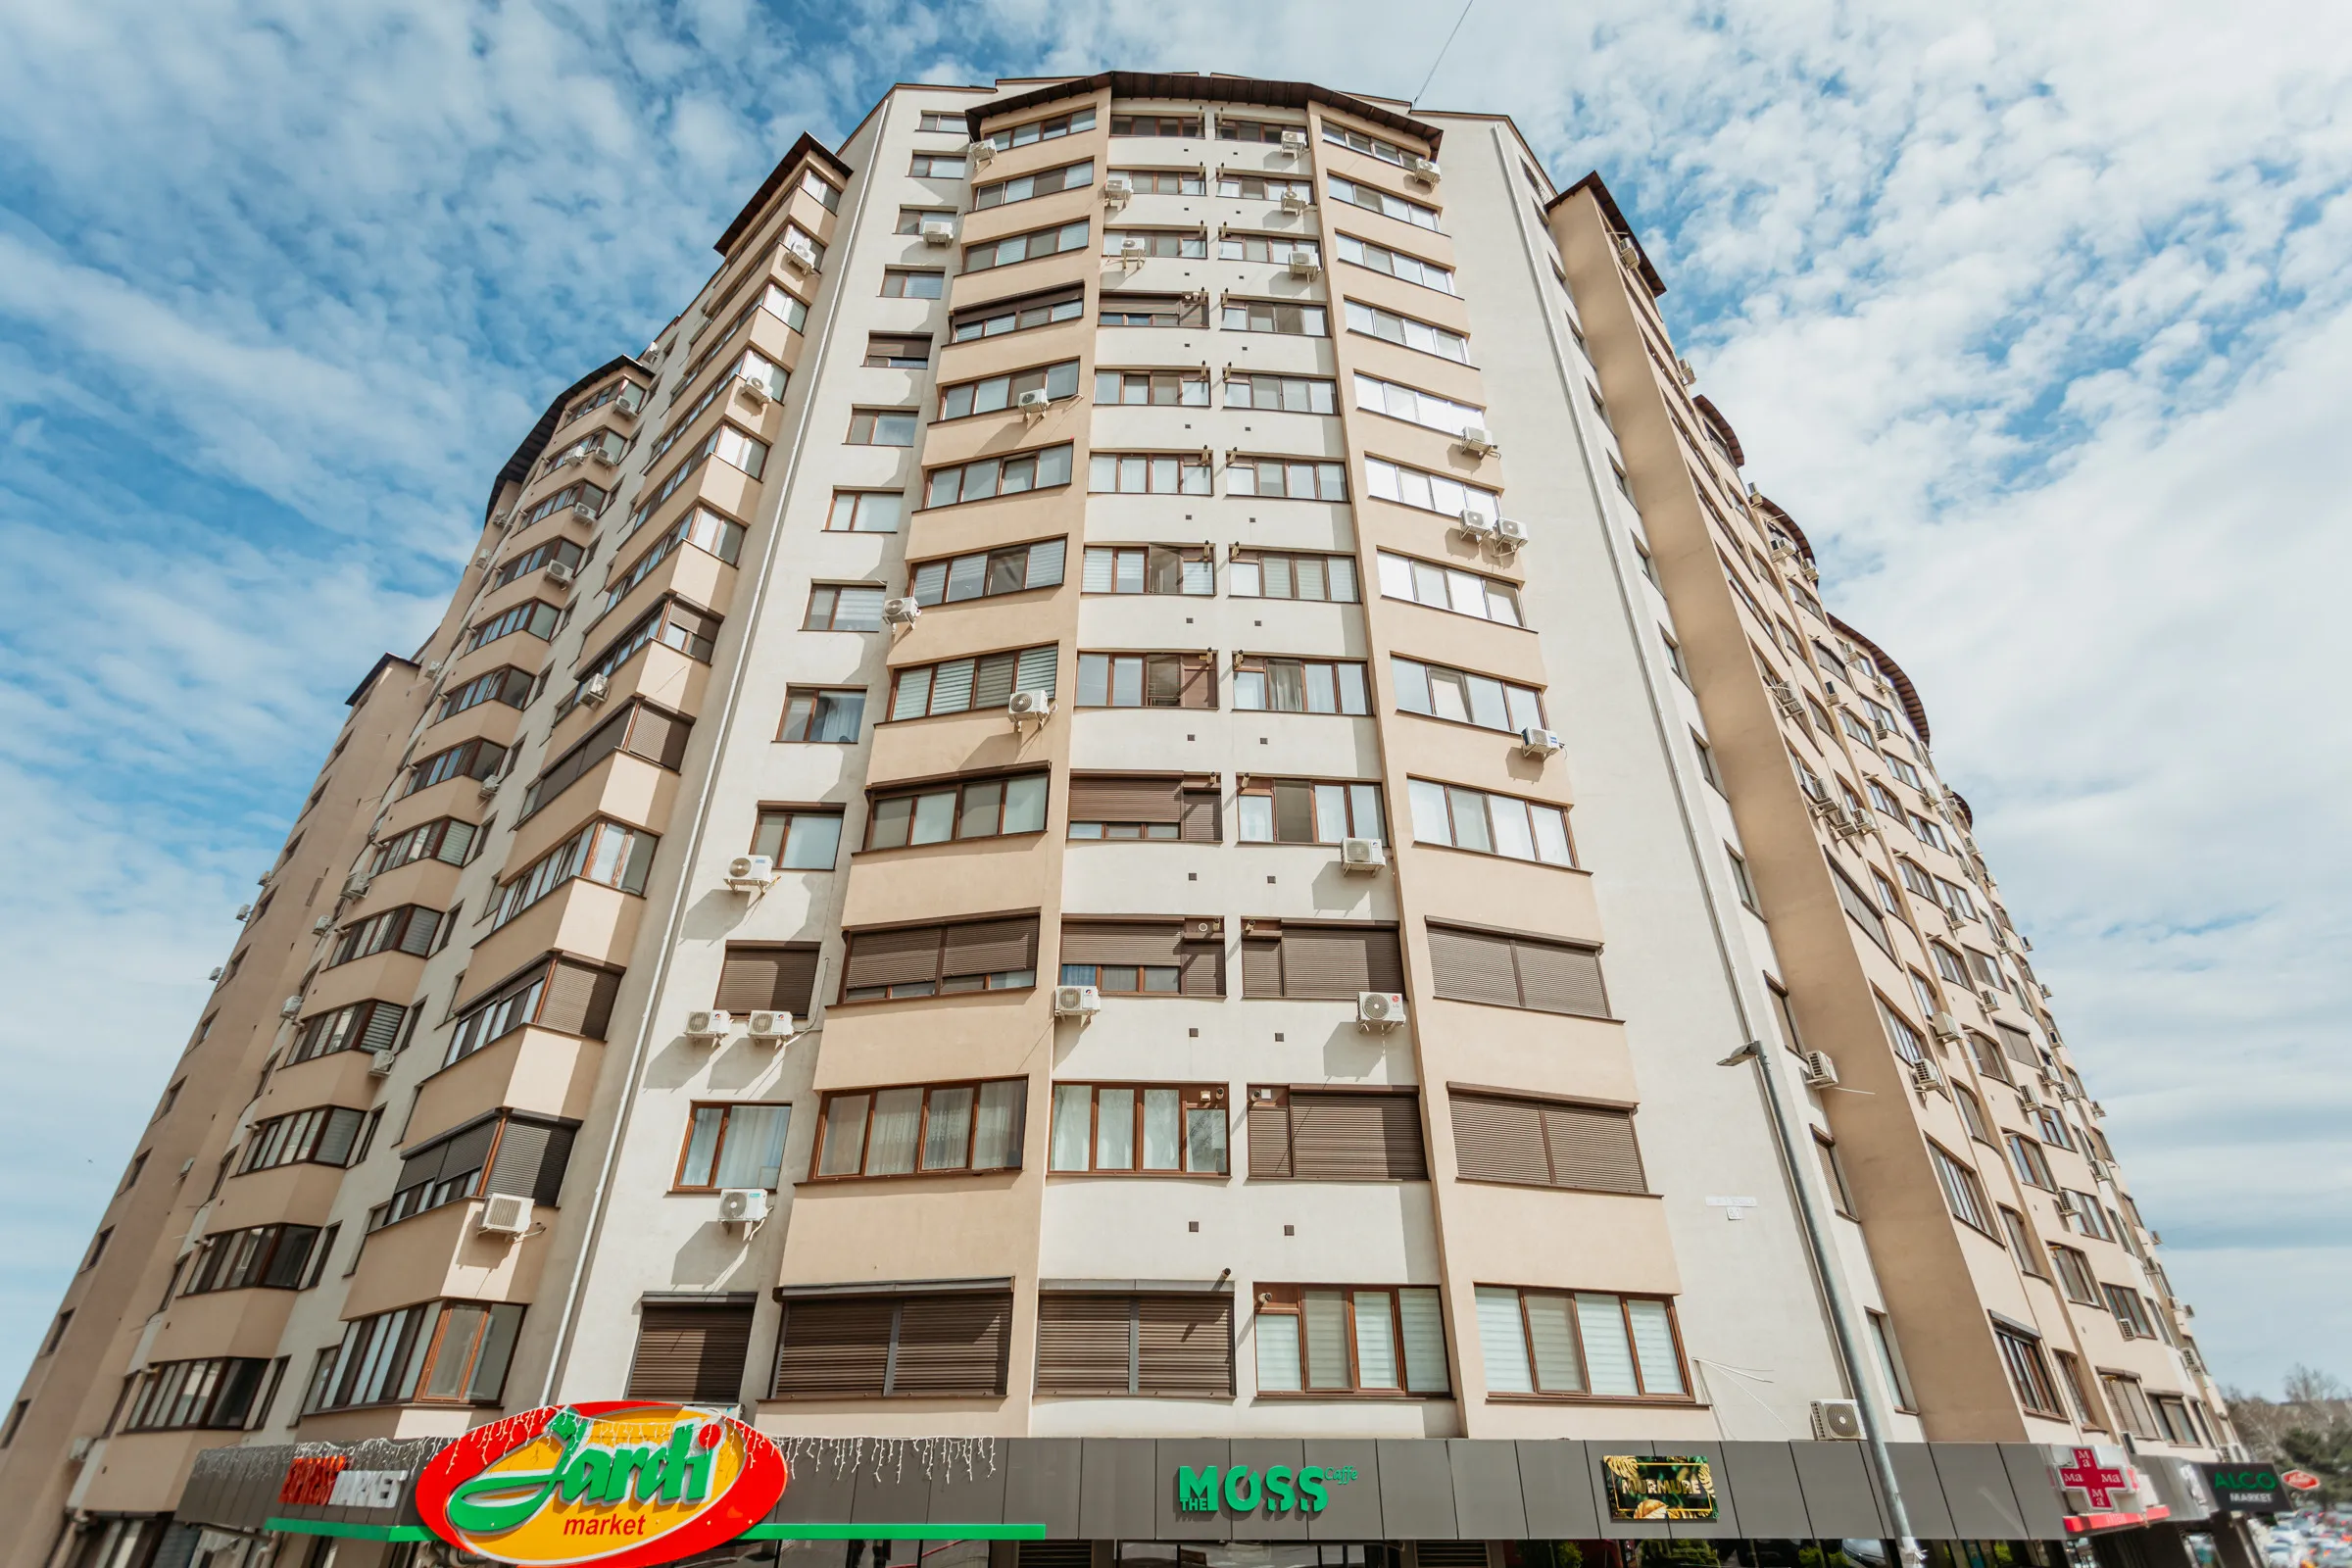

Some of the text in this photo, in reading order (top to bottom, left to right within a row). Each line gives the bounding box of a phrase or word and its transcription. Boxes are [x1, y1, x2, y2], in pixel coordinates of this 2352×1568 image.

[448, 1406, 721, 1532] Jardi
[1179, 1465, 1329, 1512] MOSS
[1622, 1479, 1701, 1494] MURMURE
[2214, 1472, 2278, 1490] ALCO
[1179, 1497, 1207, 1511] THE
[2230, 1494, 2273, 1502] MARKET
[564, 1514, 646, 1537] market
